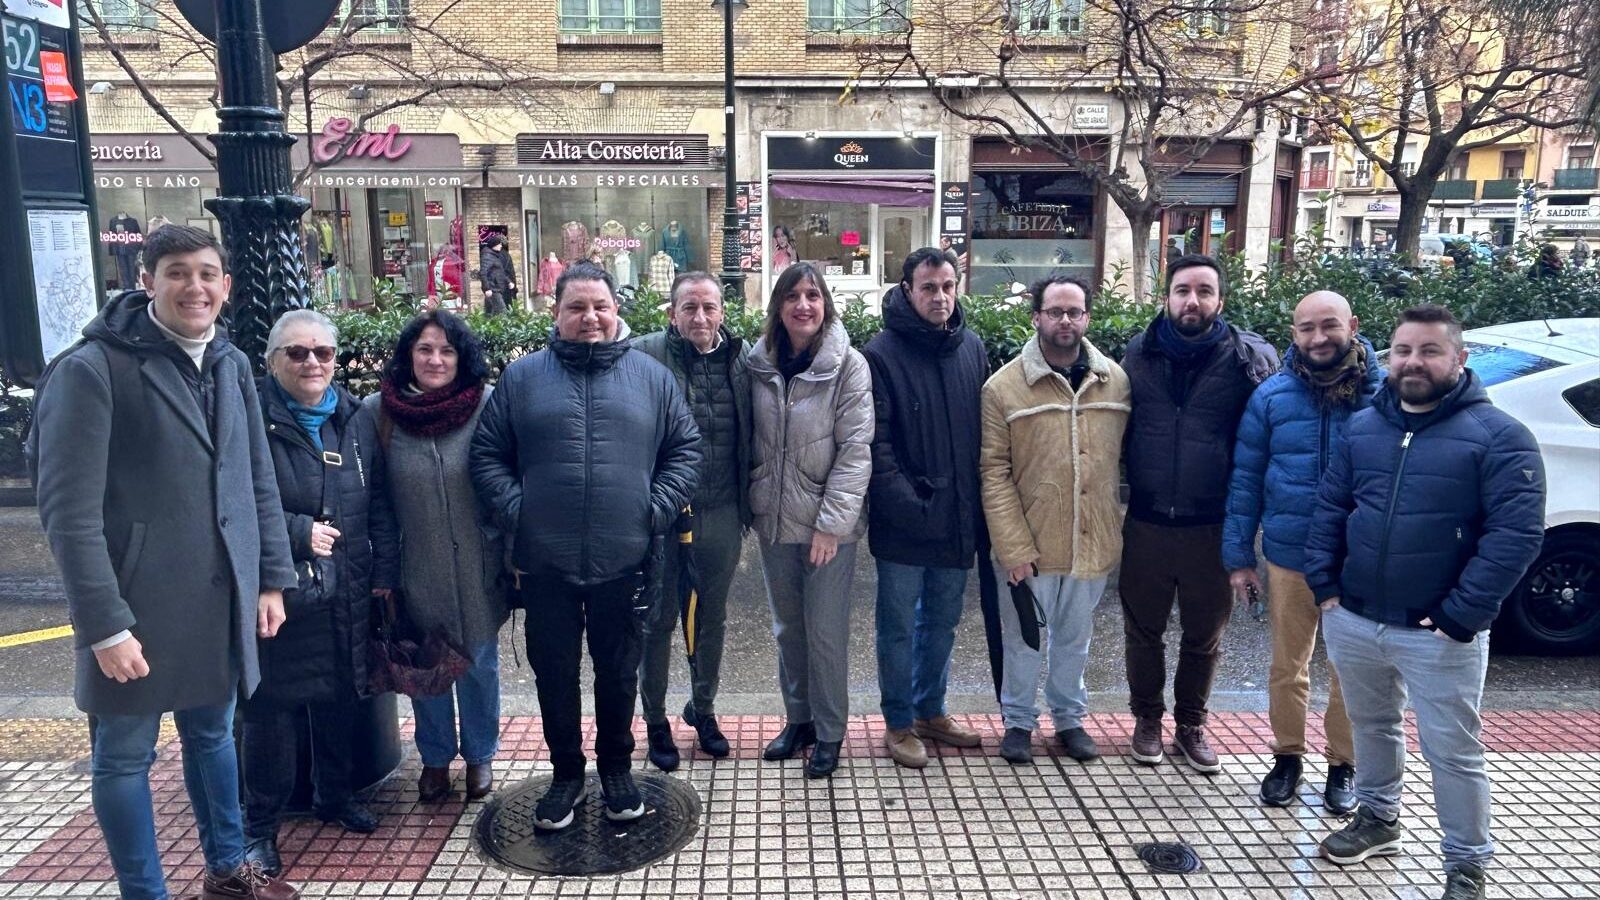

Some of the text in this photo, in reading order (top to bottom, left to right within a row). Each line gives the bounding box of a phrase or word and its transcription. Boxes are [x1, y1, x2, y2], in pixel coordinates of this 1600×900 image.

[1, 20, 40, 73] 52
[8, 81, 47, 132] N3
[314, 117, 412, 160] Emi
[90, 140, 162, 160] encería
[540, 140, 686, 160] Alta Corsetería
[833, 153, 869, 165] QUEEN
[94, 174, 200, 188] DO EL AÑO
[518, 174, 700, 186] TALLAS ESPECIALES
[1007, 215, 1066, 231] IBIZA
